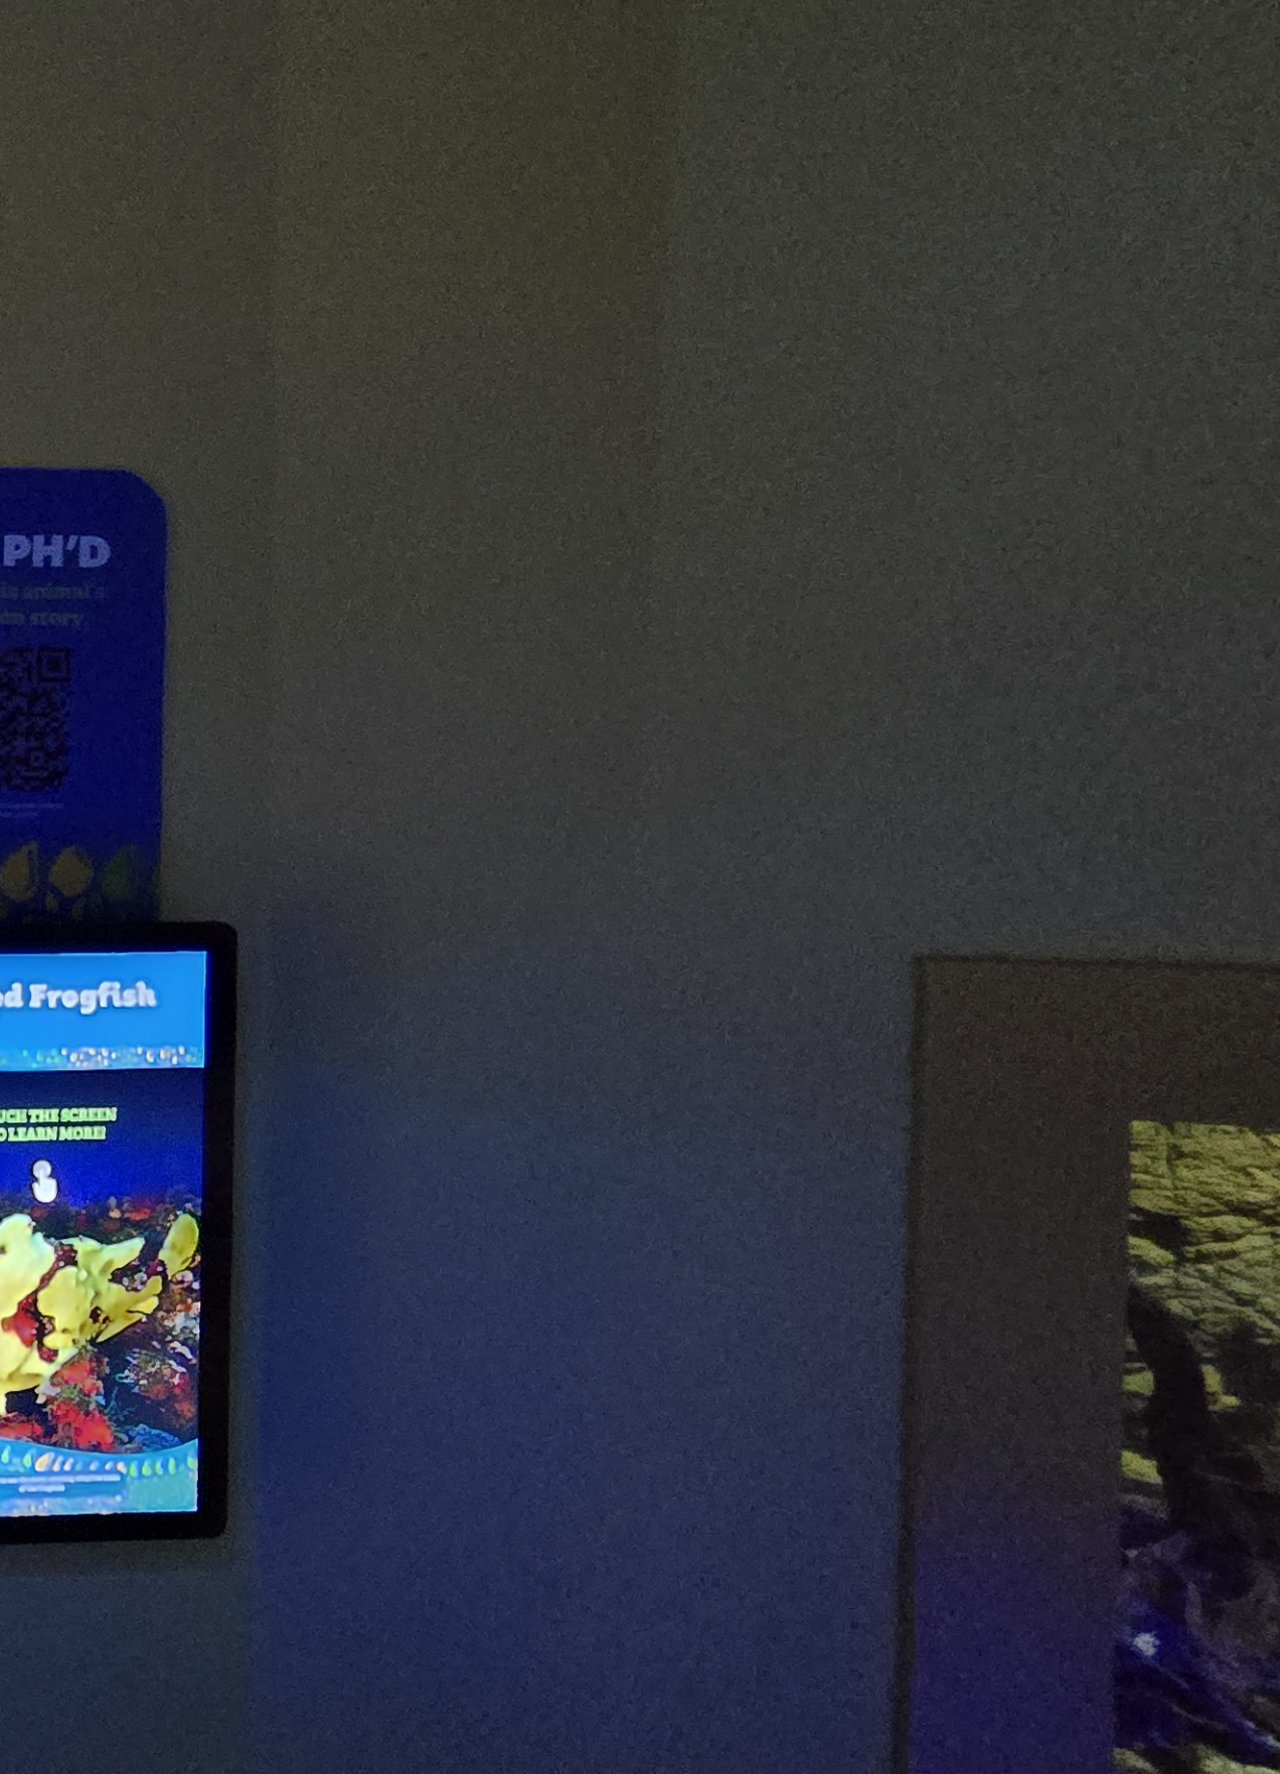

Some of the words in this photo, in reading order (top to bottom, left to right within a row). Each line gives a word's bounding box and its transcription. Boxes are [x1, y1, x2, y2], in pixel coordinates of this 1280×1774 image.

[29, 981, 157, 1015] Frogfish
[28, 1108, 59, 1122] THE
[60, 1107, 117, 1121] SCREEN
[8, 1126, 57, 1141] LEARN
